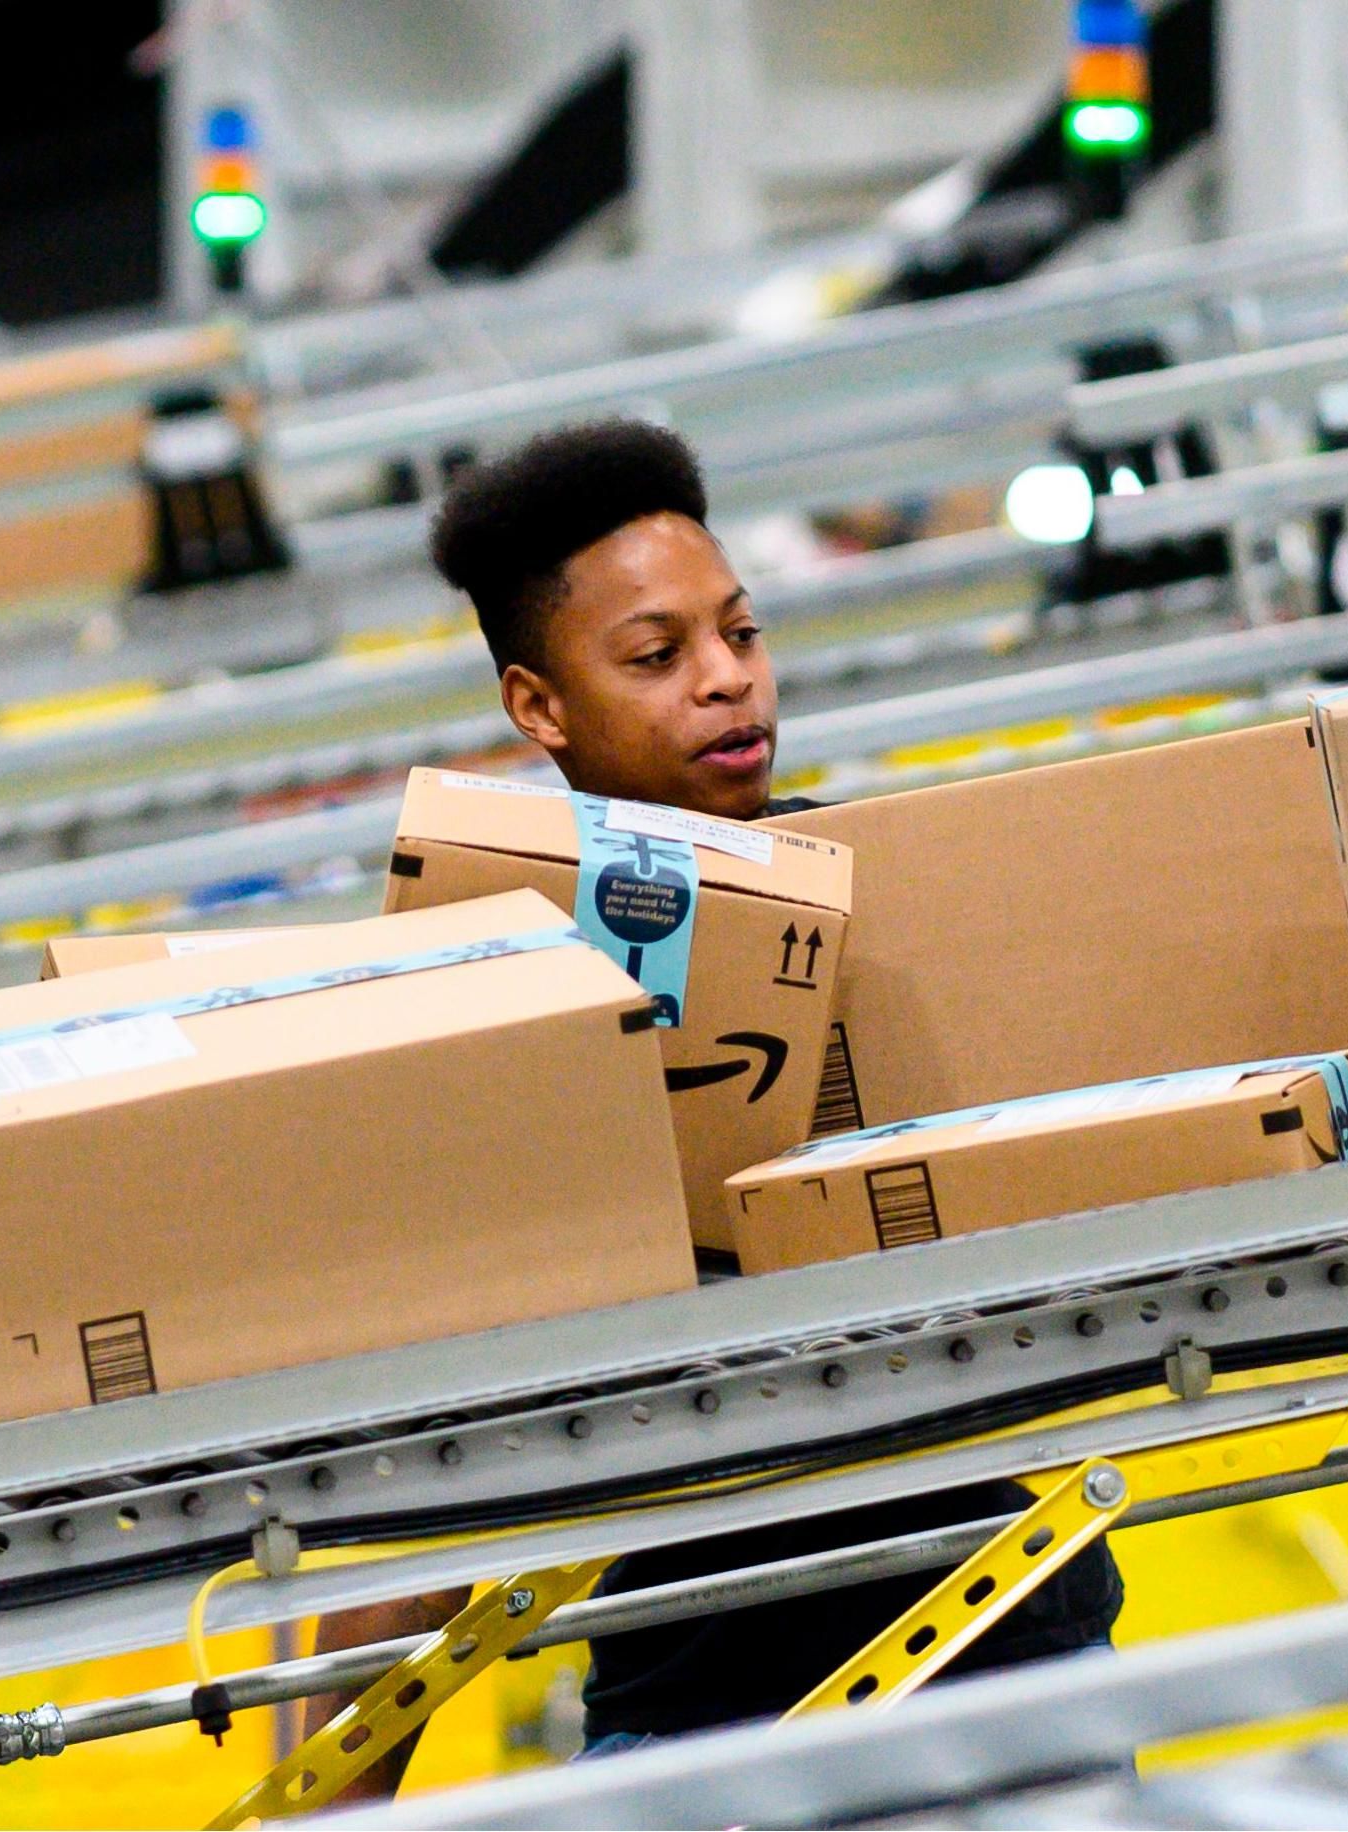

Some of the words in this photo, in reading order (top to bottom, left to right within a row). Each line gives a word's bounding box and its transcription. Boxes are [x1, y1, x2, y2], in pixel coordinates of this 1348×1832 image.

[611, 879, 676, 898] Everything
[605, 895, 627, 905] you
[630, 897, 658, 907] need
[661, 898, 679, 909] for
[605, 906, 625, 917] the
[627, 908, 676, 924] holidays
